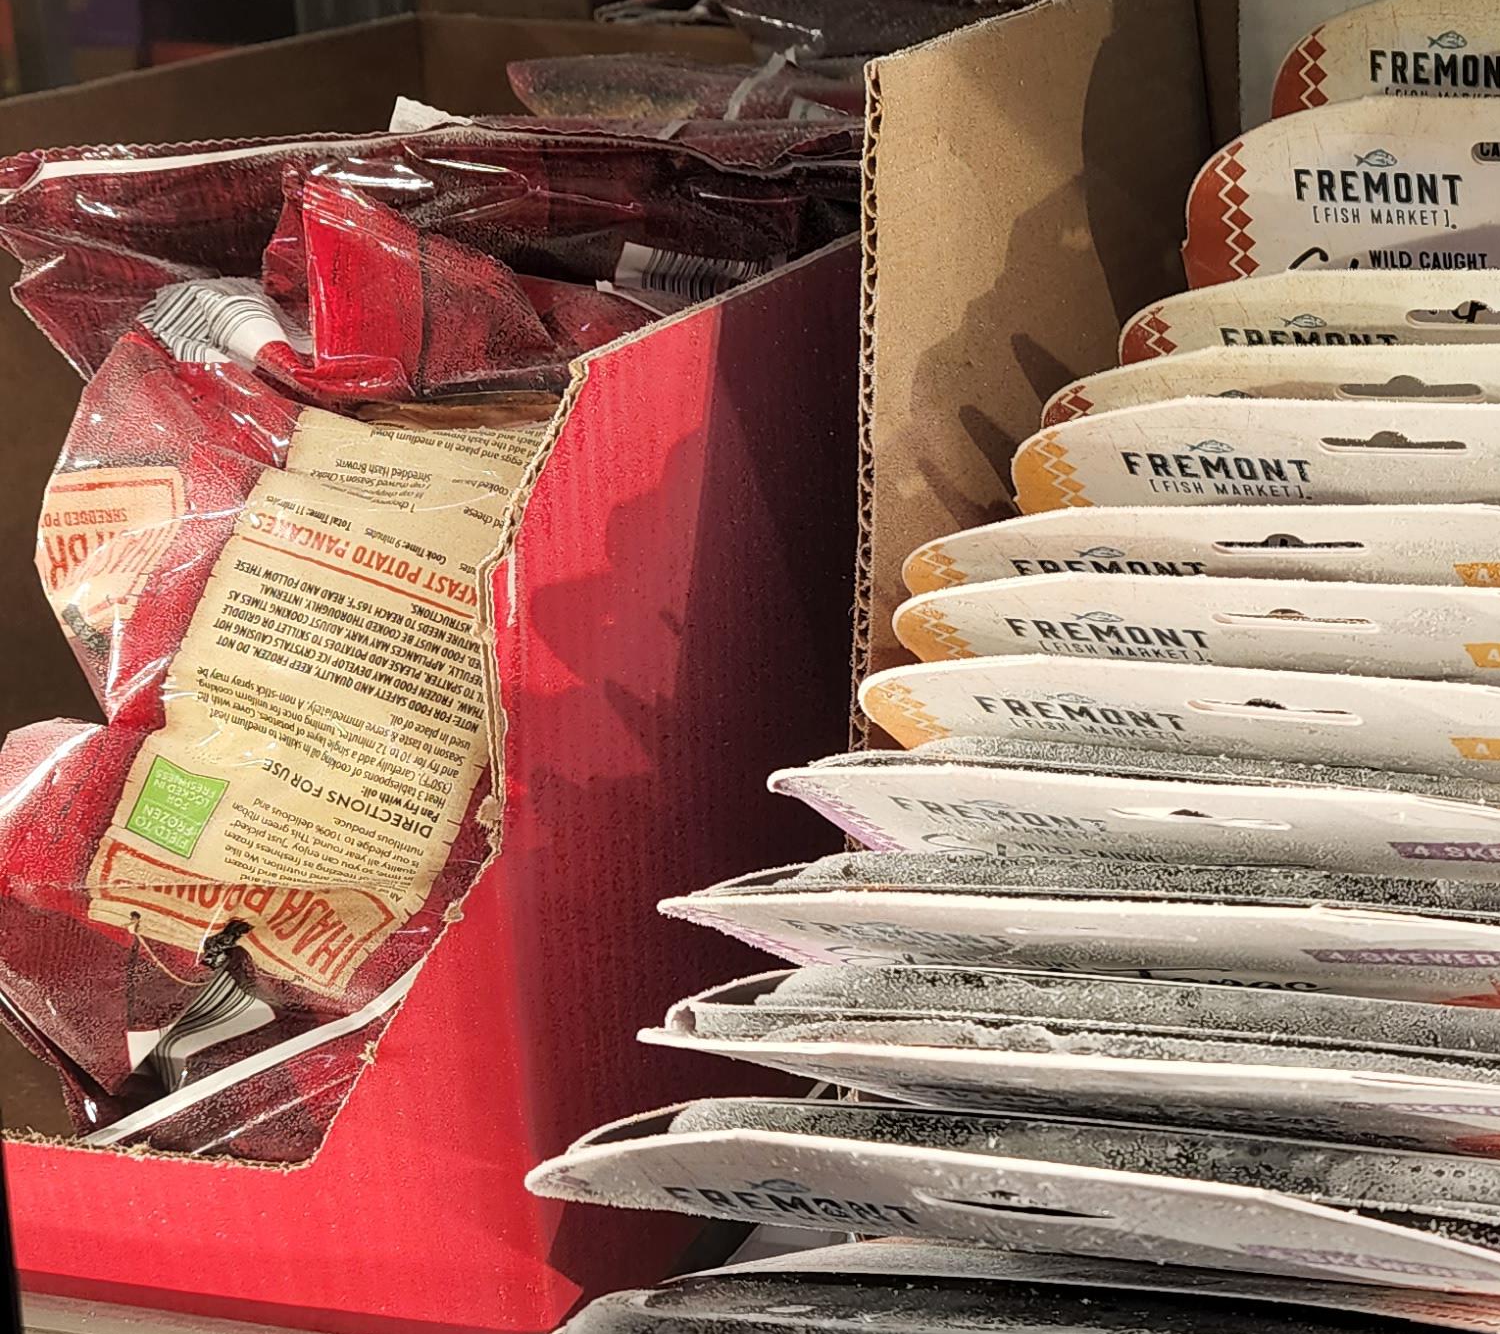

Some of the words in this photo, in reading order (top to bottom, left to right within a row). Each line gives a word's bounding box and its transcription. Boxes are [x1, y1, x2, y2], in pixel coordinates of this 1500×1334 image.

[1294, 168, 1464, 207] FREMONT
[1368, 249, 1412, 268] WILD
[1419, 252, 1488, 269] CAUGHT
[1120, 451, 1313, 484] FREMONT
[350, 542, 423, 586] POTATO
[364, 617, 402, 641] COOKED
[1004, 617, 1210, 650] FREMONT
[413, 636, 441, 655] MUST
[330, 654, 373, 680] DEVELOP
[373, 685, 409, 708] SAFETY
[391, 676, 419, 696] FOOD
[416, 686, 454, 709] FROZEN
[406, 698, 434, 717] FOOD
[973, 695, 1187, 732] FREMONT
[259, 756, 292, 780] USE
[289, 773, 324, 798] FOR
[361, 766, 418, 800] tablespoons
[324, 786, 434, 840] DIRECTIONS
[374, 831, 425, 859] nutritious
[662, 1184, 921, 1226] FREMONT
